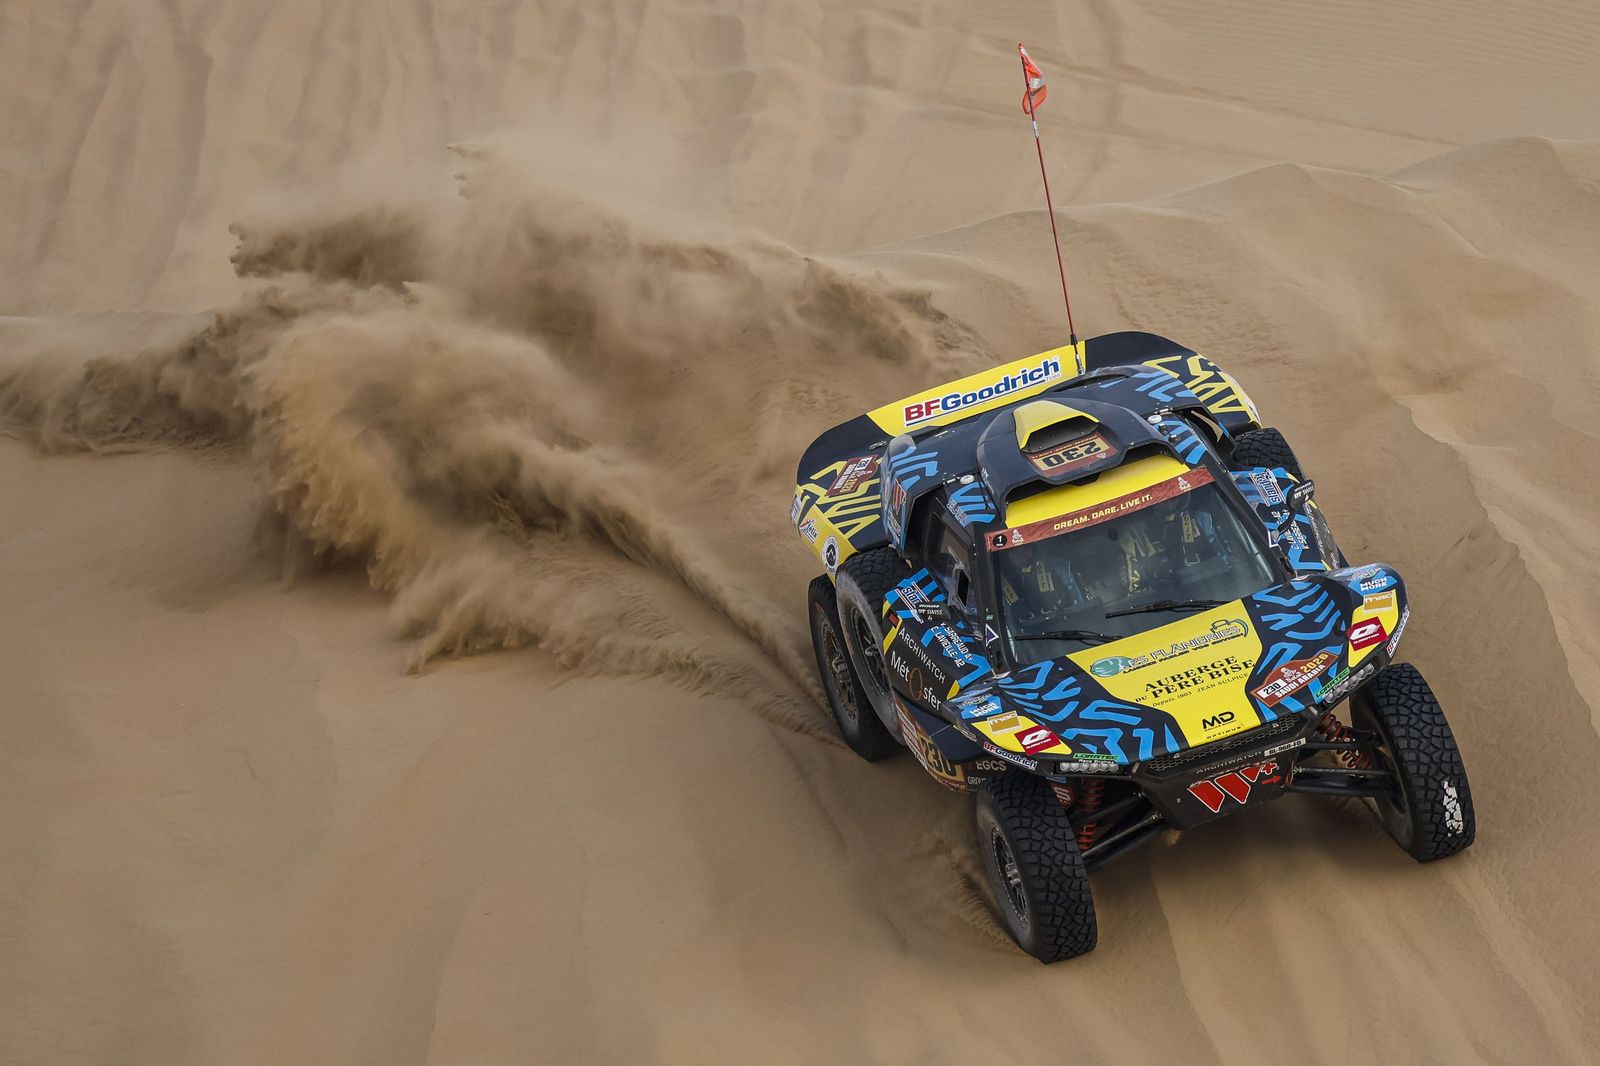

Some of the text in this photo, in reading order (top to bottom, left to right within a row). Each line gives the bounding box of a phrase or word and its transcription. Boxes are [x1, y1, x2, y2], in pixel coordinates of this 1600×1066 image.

[904, 360, 1061, 422] BFGoodrich
[1042, 440, 1102, 467] 230
[1053, 494, 1153, 531] DREAM. DARE. LIVE IT.
[1360, 577, 1388, 588] MUCH
[1360, 582, 1388, 592] MORE
[898, 627, 946, 684] ARCHIWATCH
[1300, 653, 1329, 674] 2026
[1135, 695, 1148, 703] DU
[1209, 659, 1255, 681] BISE
[1145, 655, 1238, 692] AUBERGE
[1274, 680, 1299, 698] SAUDI
[1299, 664, 1326, 685] ARABIA
[1152, 673, 1250, 708] Depuis 1903 JEAN SULPICE
[1263, 682, 1281, 695] 230
[1201, 711, 1236, 730] MD
[1206, 726, 1242, 740] OPTIMUS
[983, 742, 1038, 769] BFGoodrich
